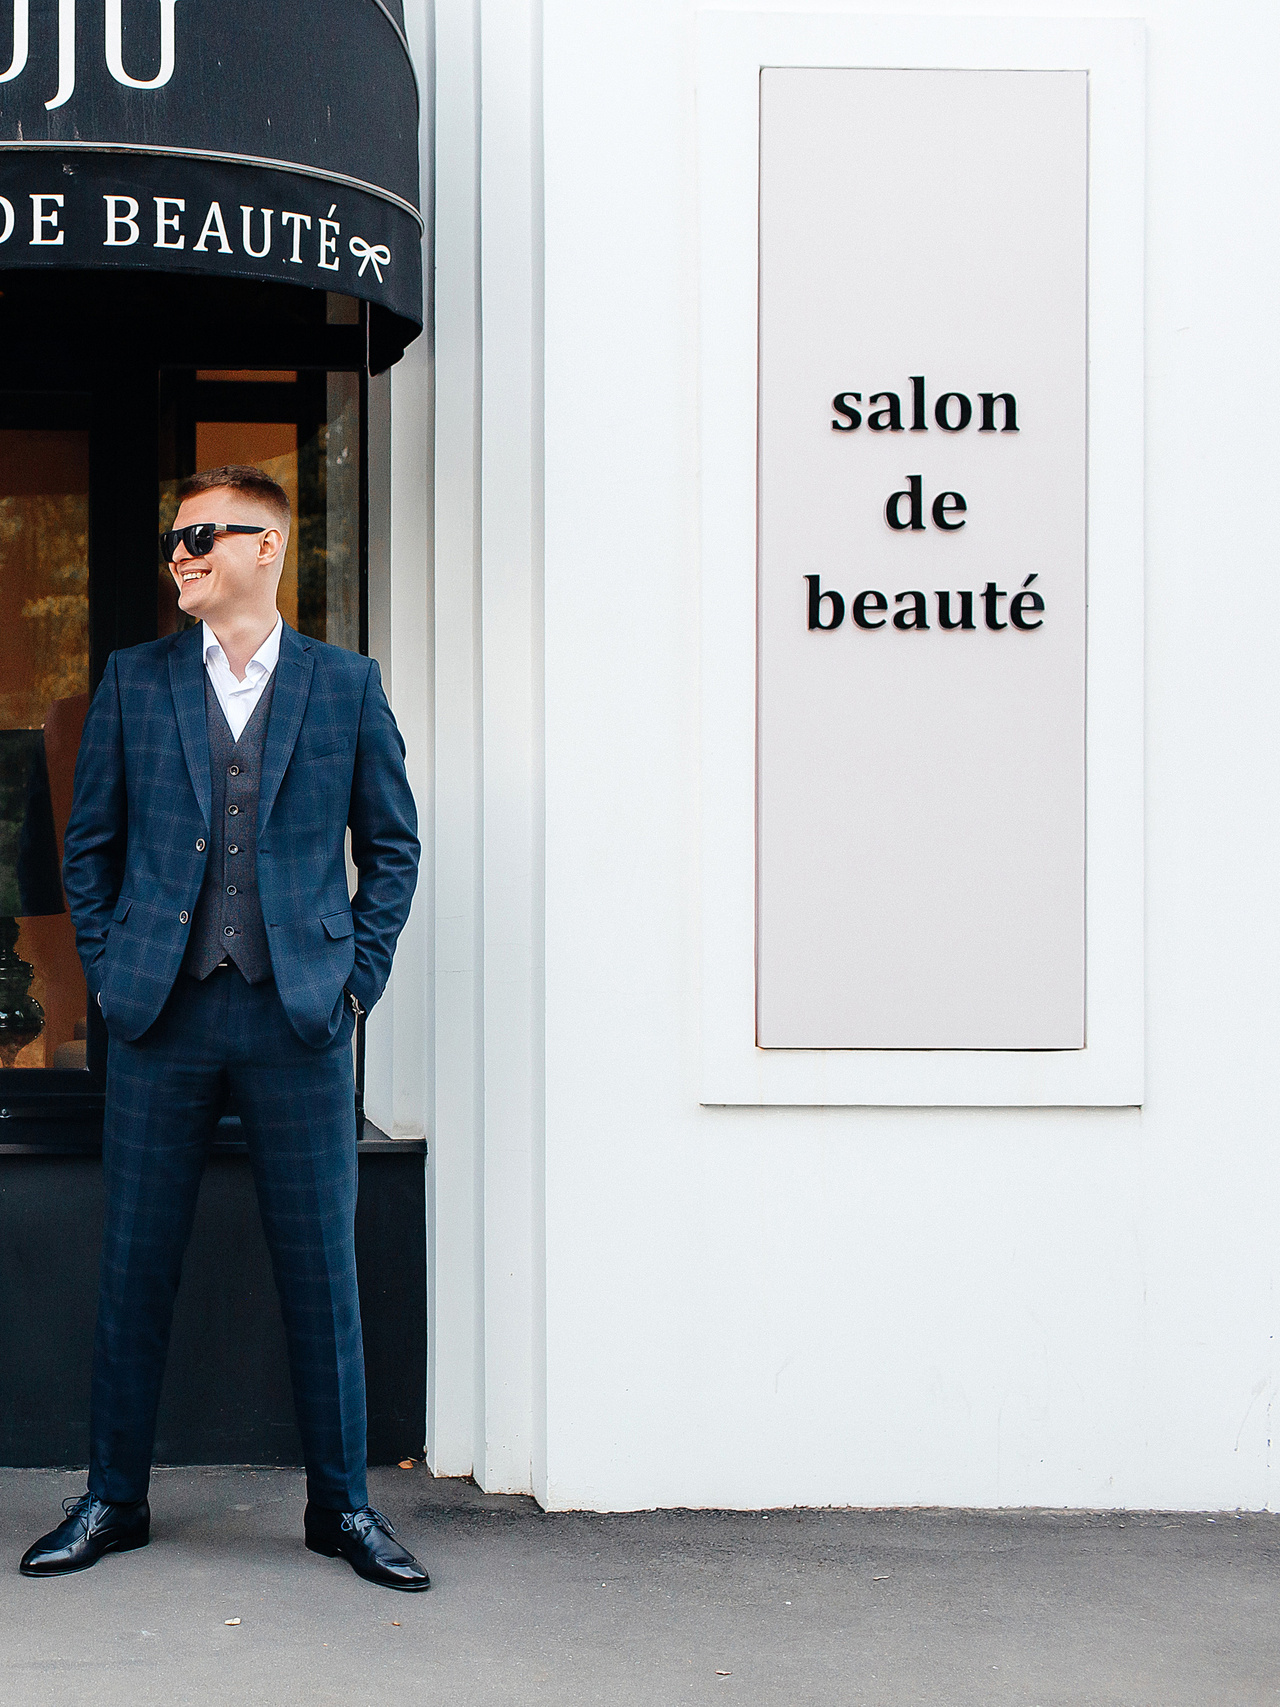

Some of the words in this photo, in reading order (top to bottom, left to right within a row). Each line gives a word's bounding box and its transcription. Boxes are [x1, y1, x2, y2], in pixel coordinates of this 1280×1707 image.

[102, 194, 342, 272] BEAUTÉ
[831, 376, 1020, 433] salon
[885, 474, 967, 532] de
[804, 573, 1046, 632] beauté
